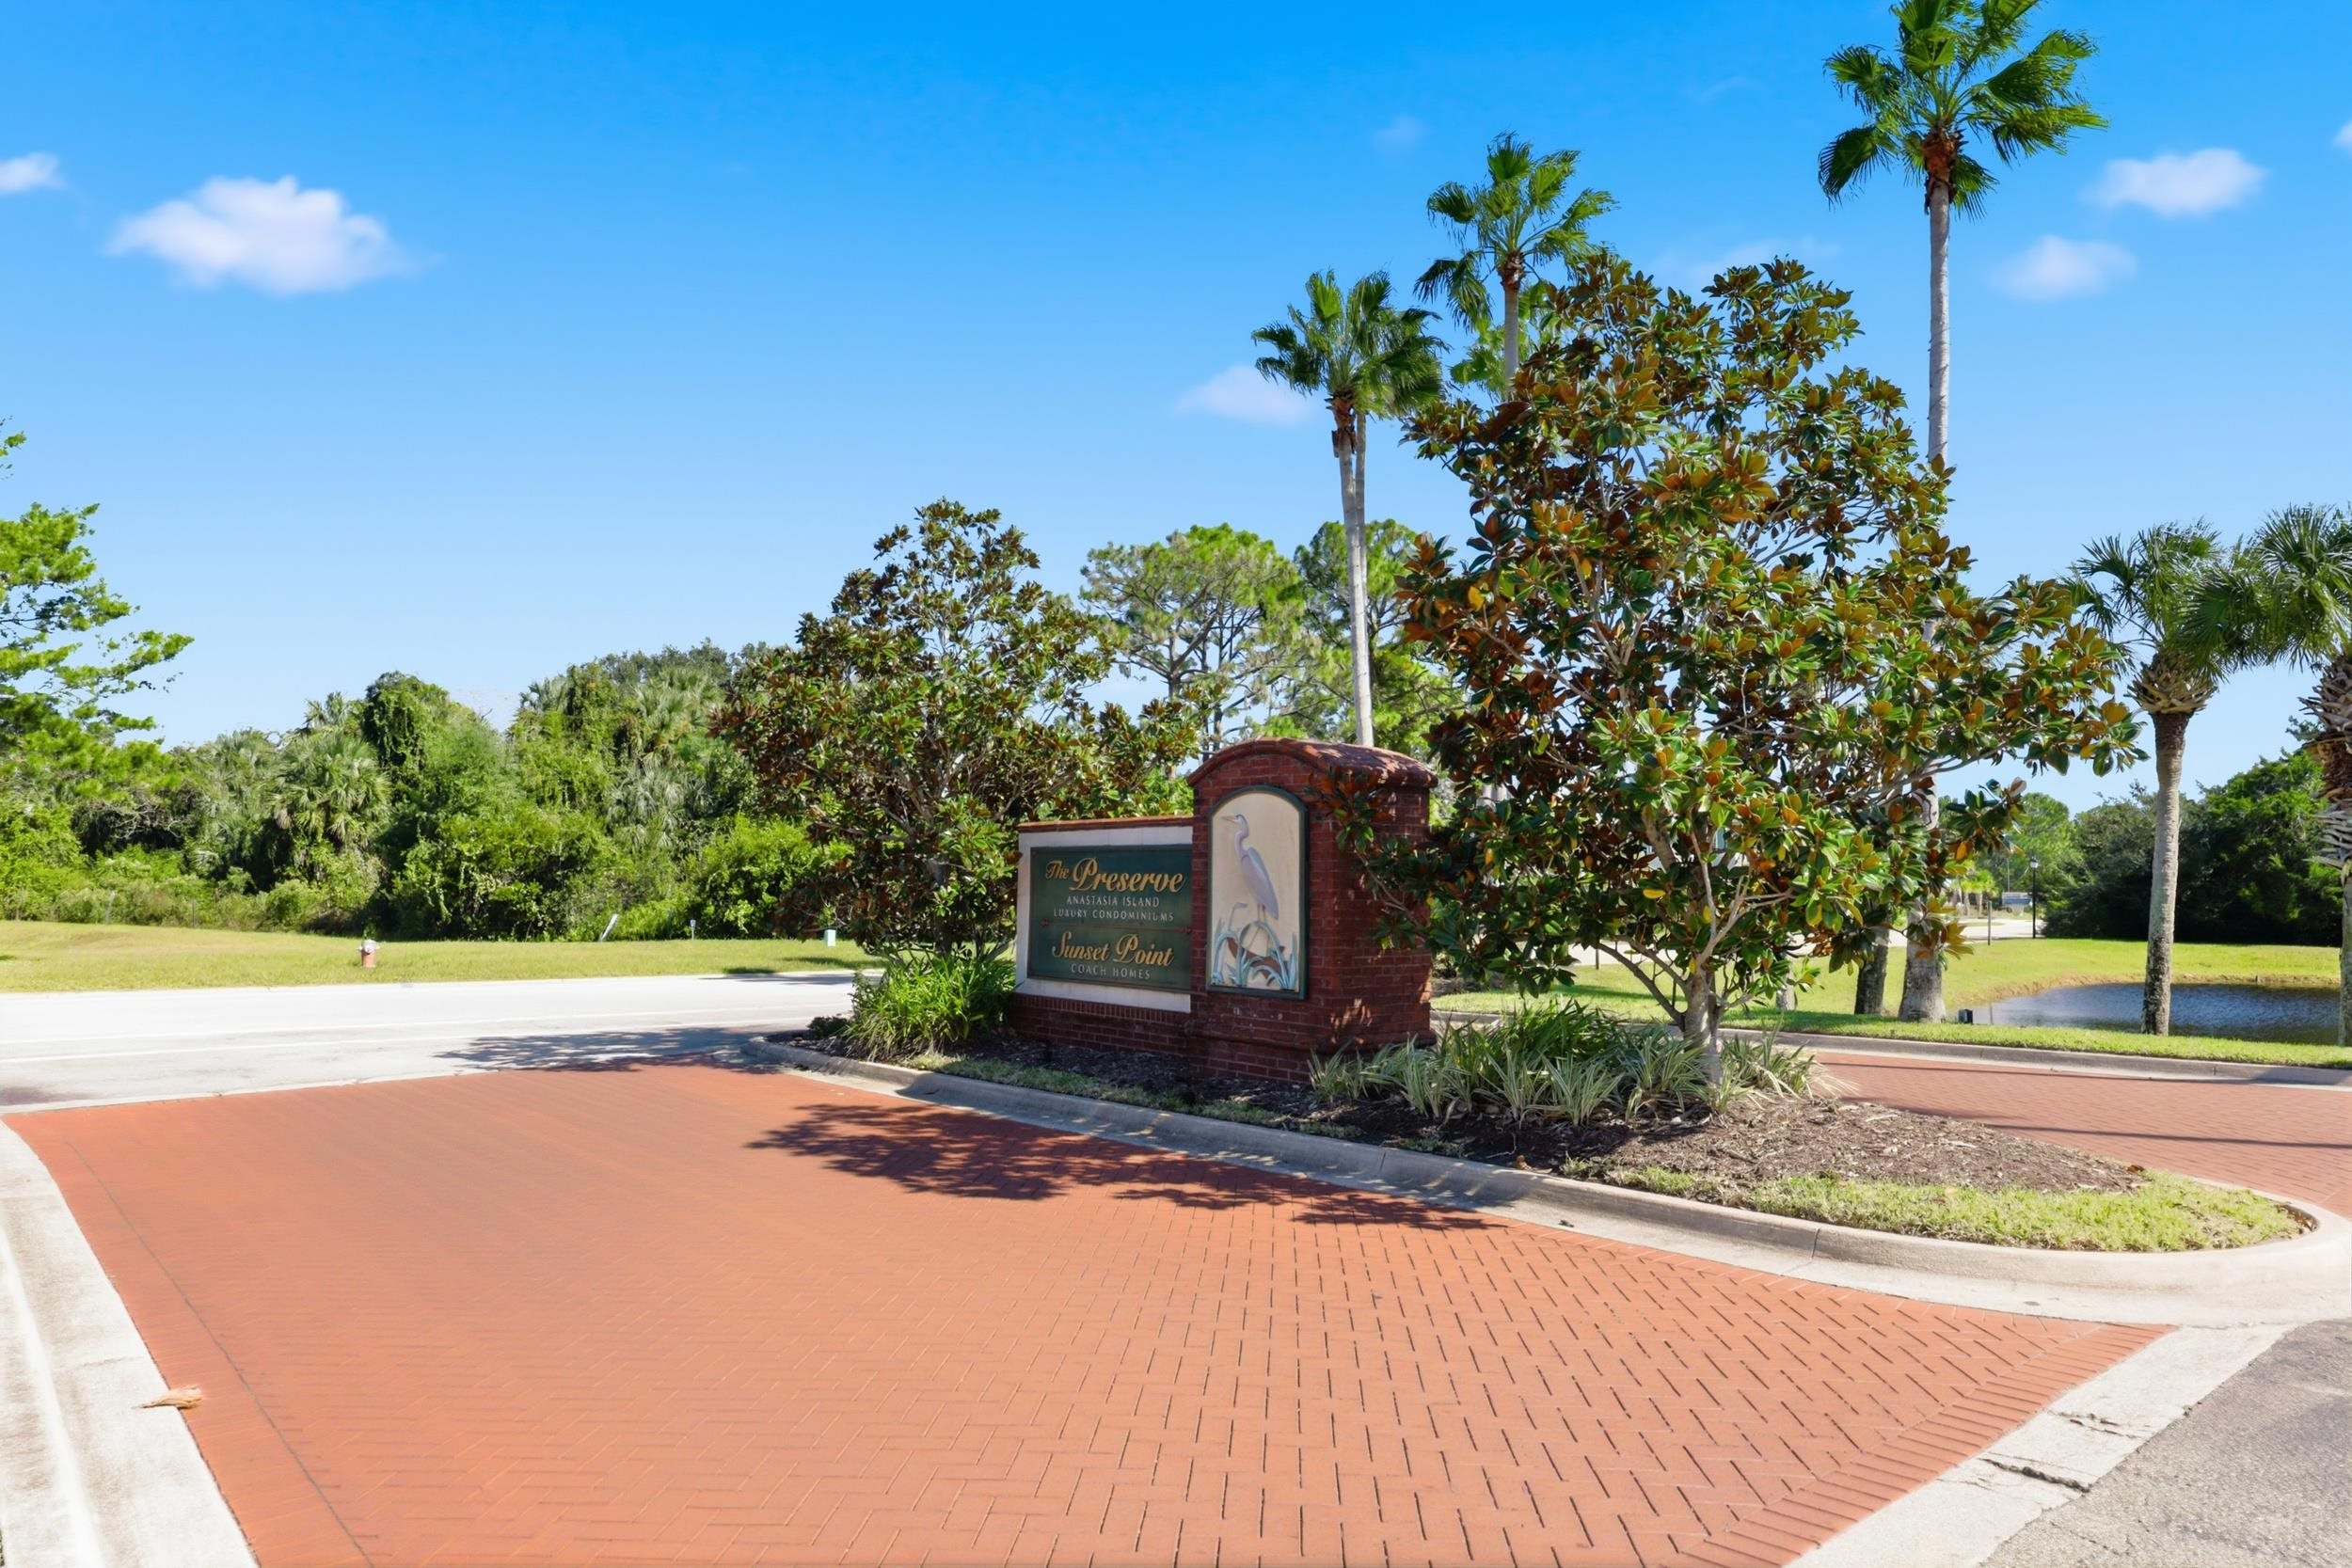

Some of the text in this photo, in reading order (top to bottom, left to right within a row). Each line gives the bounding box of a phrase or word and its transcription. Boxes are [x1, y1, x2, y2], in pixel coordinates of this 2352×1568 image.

[1045, 857, 1184, 893] The Preserve
[1066, 895, 1160, 908] ANASTASIA ISLAND
[1053, 908, 1175, 922] LUXURY CONDOMINIUMS
[1052, 930, 1174, 968] Sunset Point
[1071, 963, 1151, 980] COACH HOMES
